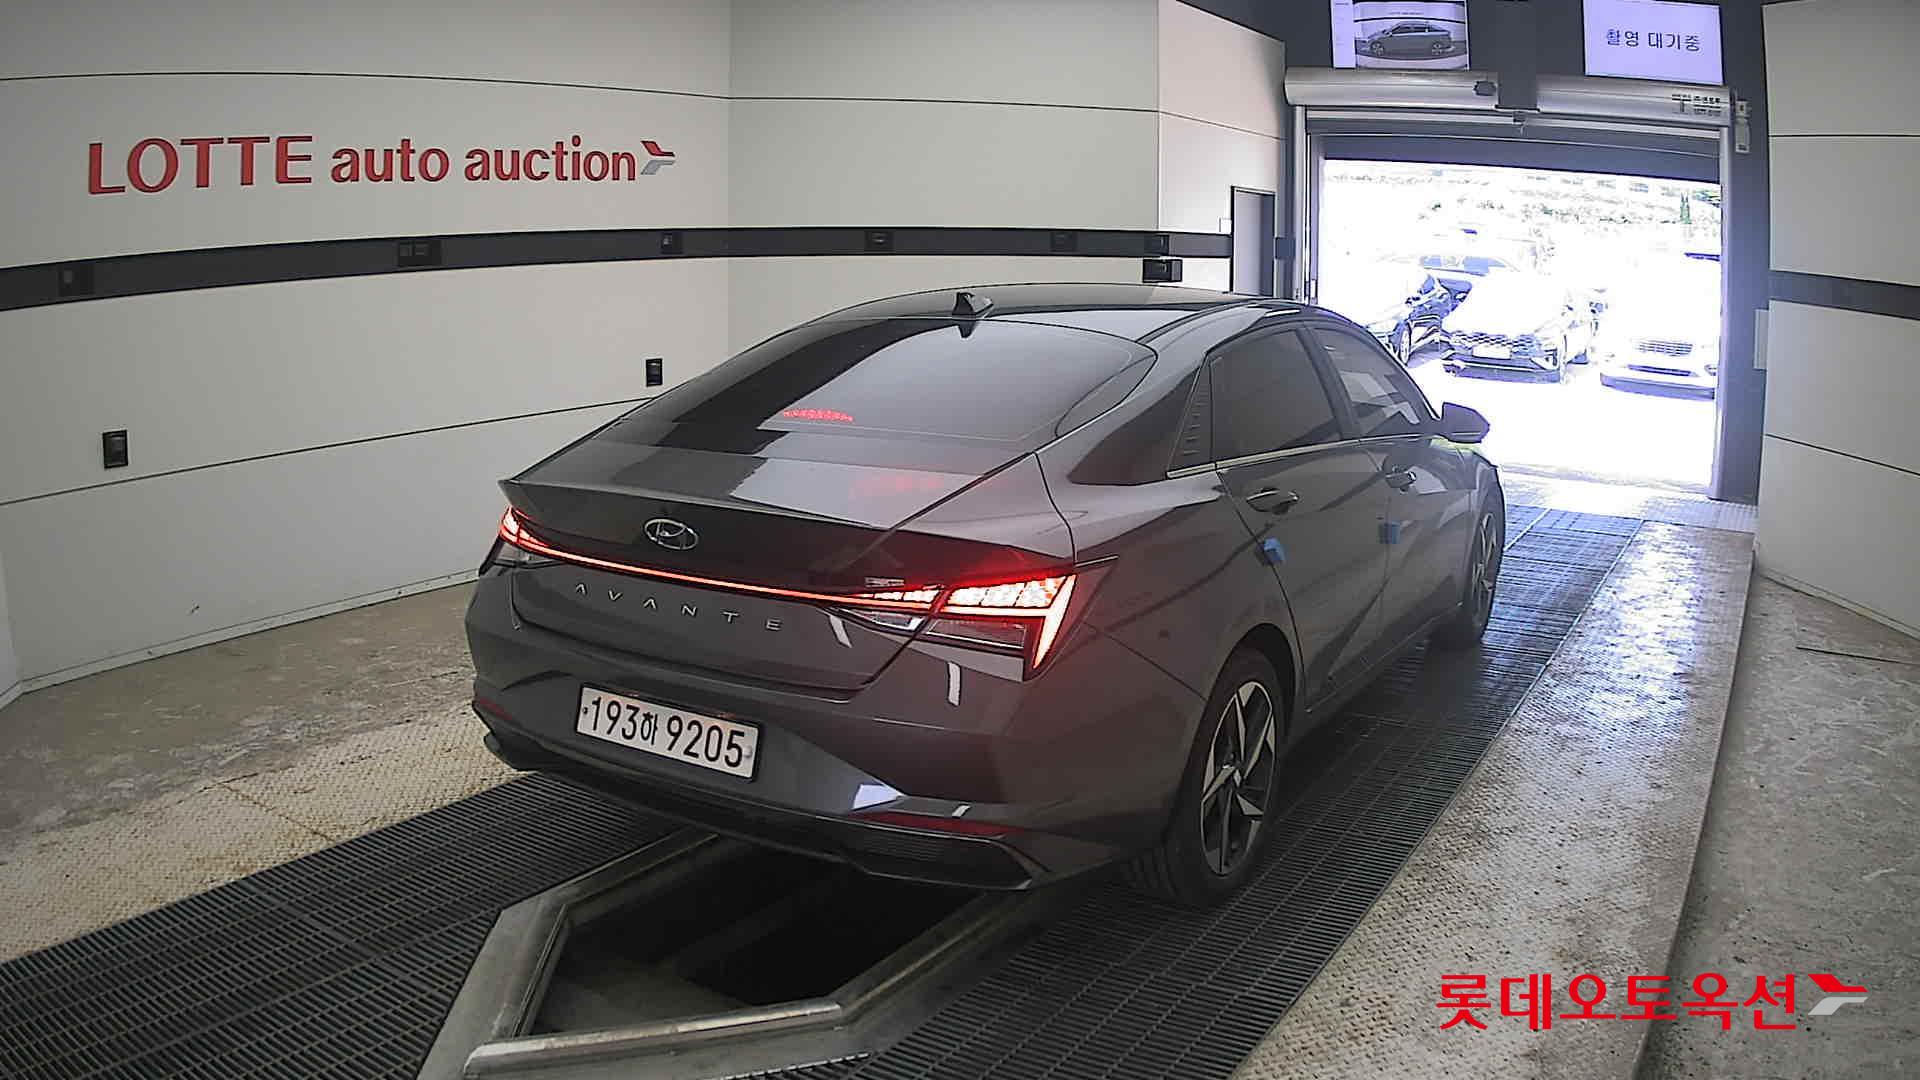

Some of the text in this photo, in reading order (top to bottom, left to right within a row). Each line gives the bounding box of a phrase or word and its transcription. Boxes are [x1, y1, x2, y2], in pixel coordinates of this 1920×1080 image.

[1647, 31, 1700, 52] 대기중
[89, 135, 637, 194] LOTTE auto auction
[575, 583, 783, 631] AVANTE
